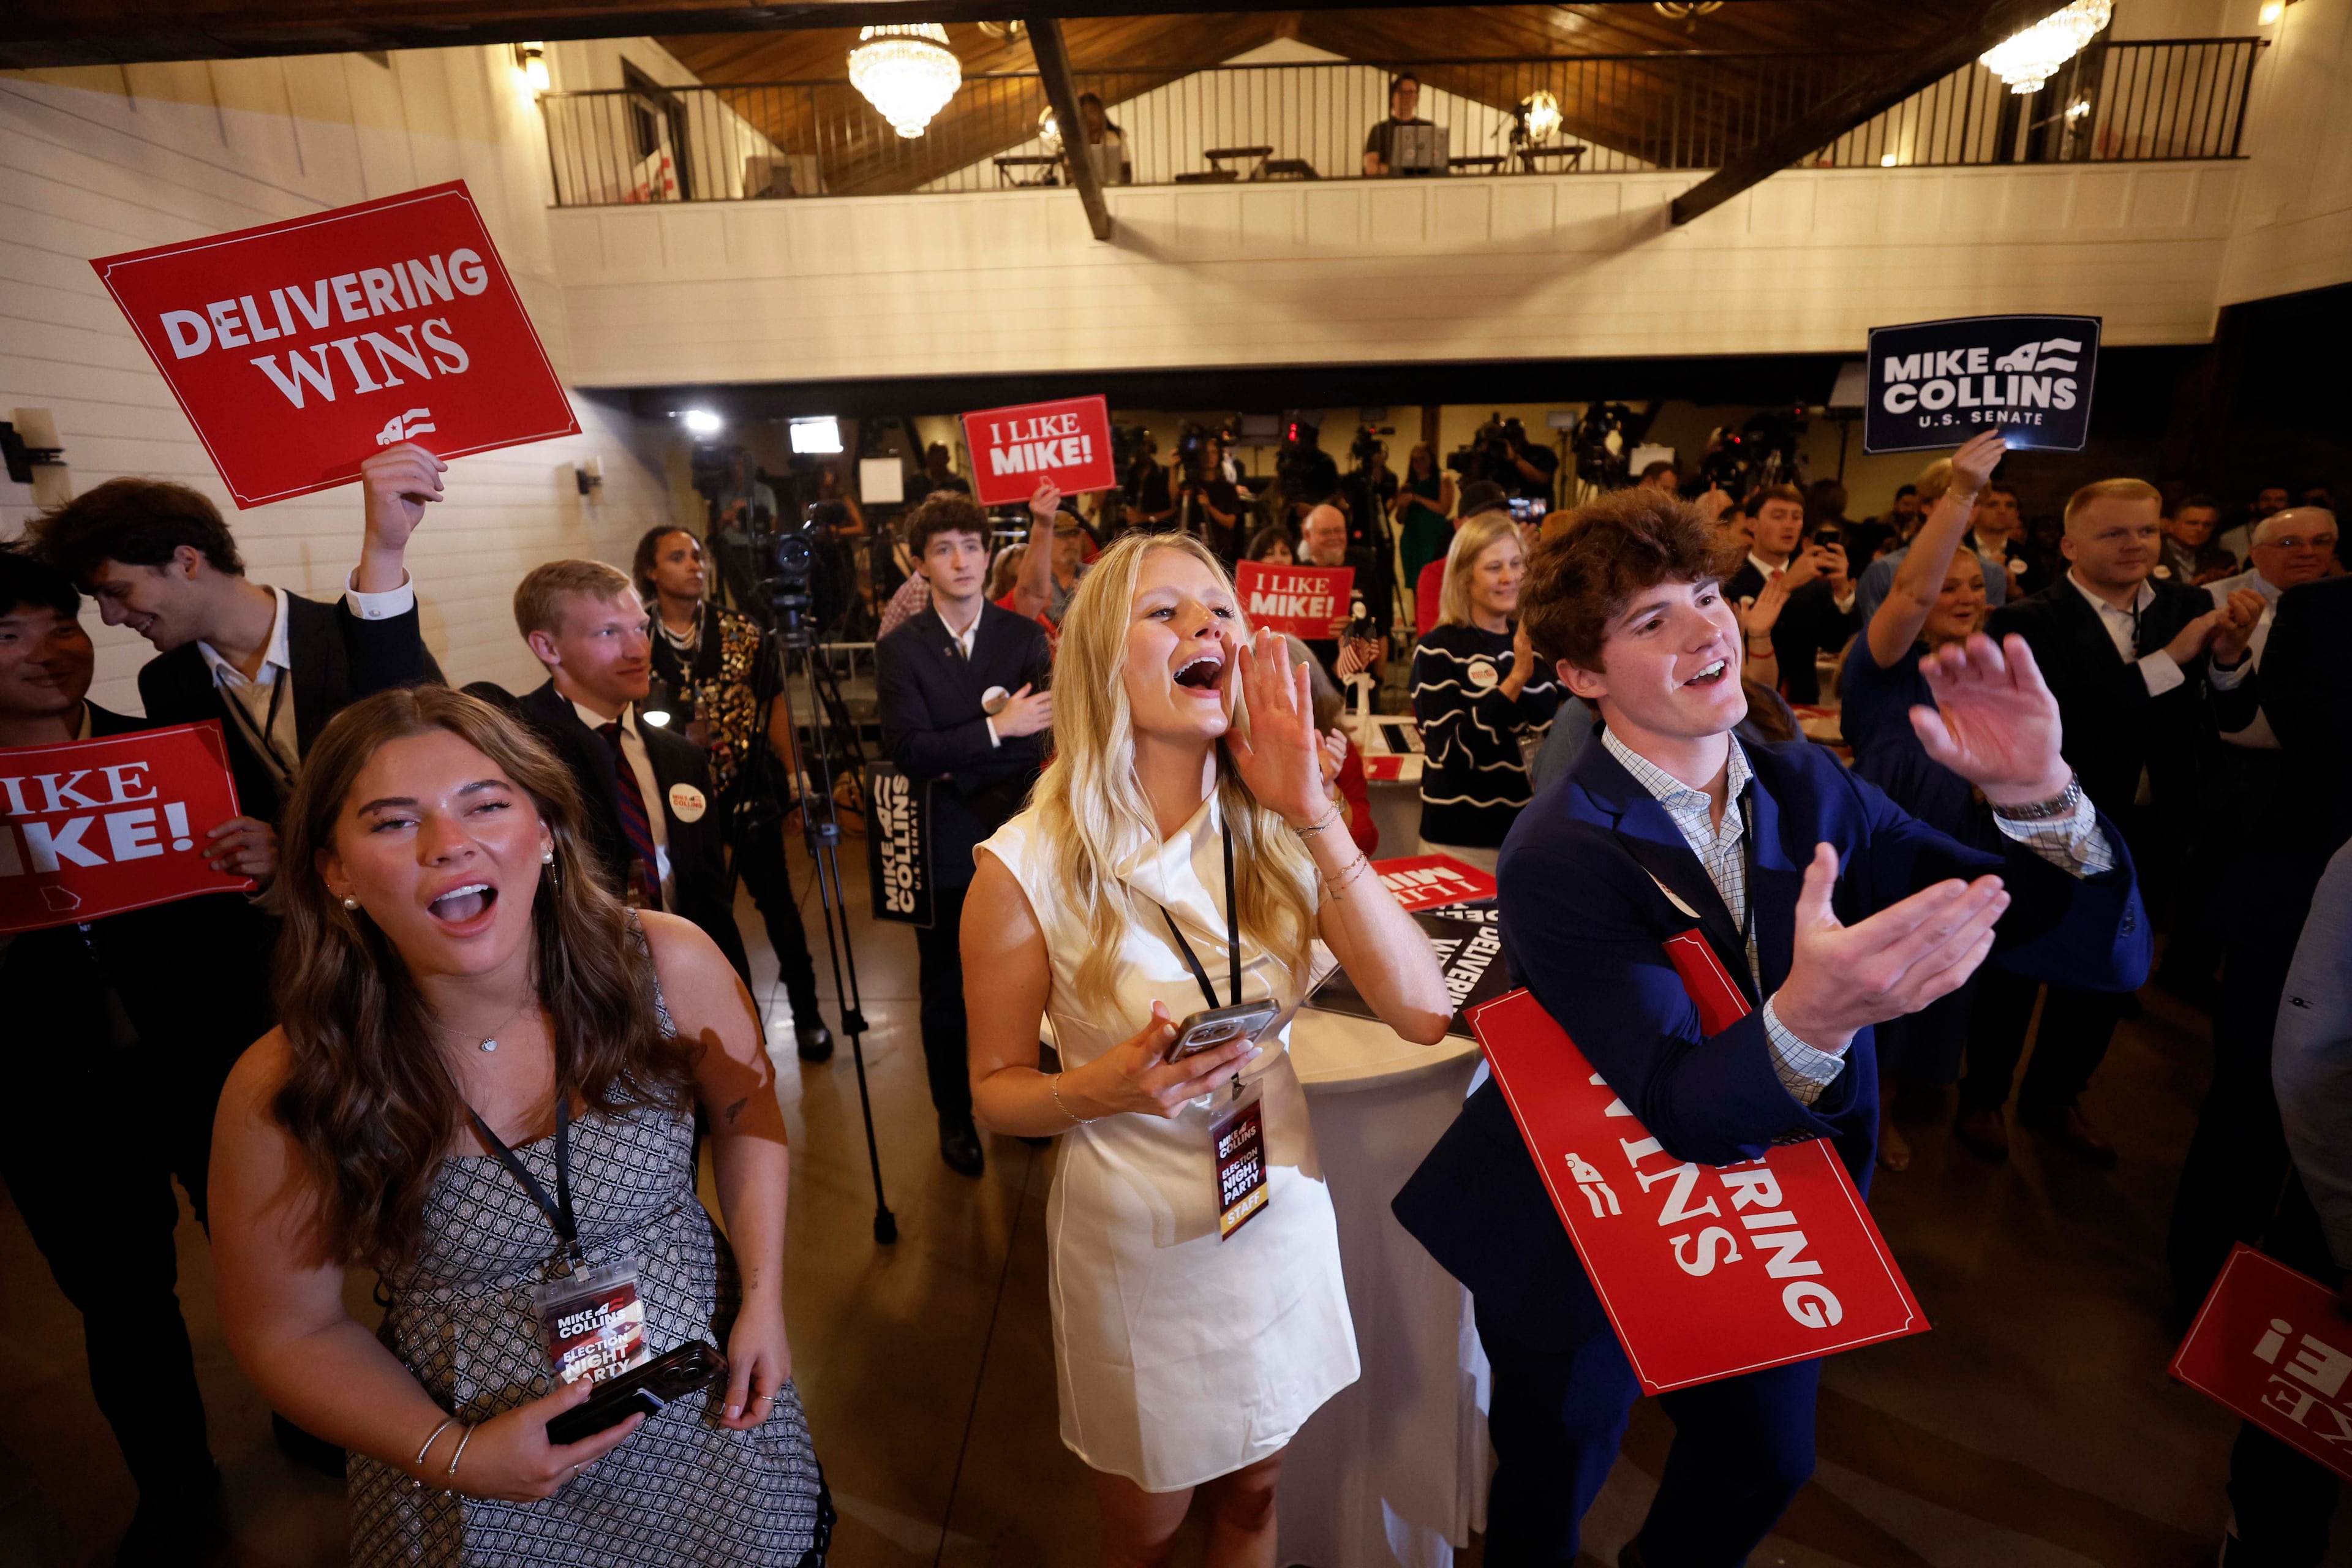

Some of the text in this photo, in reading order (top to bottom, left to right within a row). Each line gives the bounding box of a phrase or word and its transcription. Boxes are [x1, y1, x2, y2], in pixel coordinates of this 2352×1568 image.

[160, 248, 489, 360] DELIVERING
[249, 317, 470, 409] WINS
[1883, 347, 1989, 383] MIKE
[1882, 374, 2078, 415] COLLINS
[989, 412, 1081, 445] I LIKE
[1918, 410, 2043, 428] U.S. SENATE
[989, 434, 1093, 477] MIKE!
[1256, 573, 1330, 595] I LIKE
[1250, 590, 1335, 619] MIKE!
[0, 761, 158, 816] IKE
[0, 801, 194, 877] IKE!
[892, 774, 915, 913] COLLINS
[881, 841, 900, 911] MIKE
[1219, 1128, 1238, 1150] MIKE
[1219, 1125, 1256, 1159] COLLINS
[1221, 1147, 1258, 1180] ELECTION
[1223, 1156, 1259, 1193] NIGHT
[1224, 1169, 1259, 1207] PARTY
[1227, 1191, 1261, 1226] STAFF
[557, 1309, 594, 1329] MIKE
[559, 1309, 627, 1339] COLLINS
[562, 1332, 628, 1363] ELECTION
[564, 1344, 629, 1378] NIGHT
